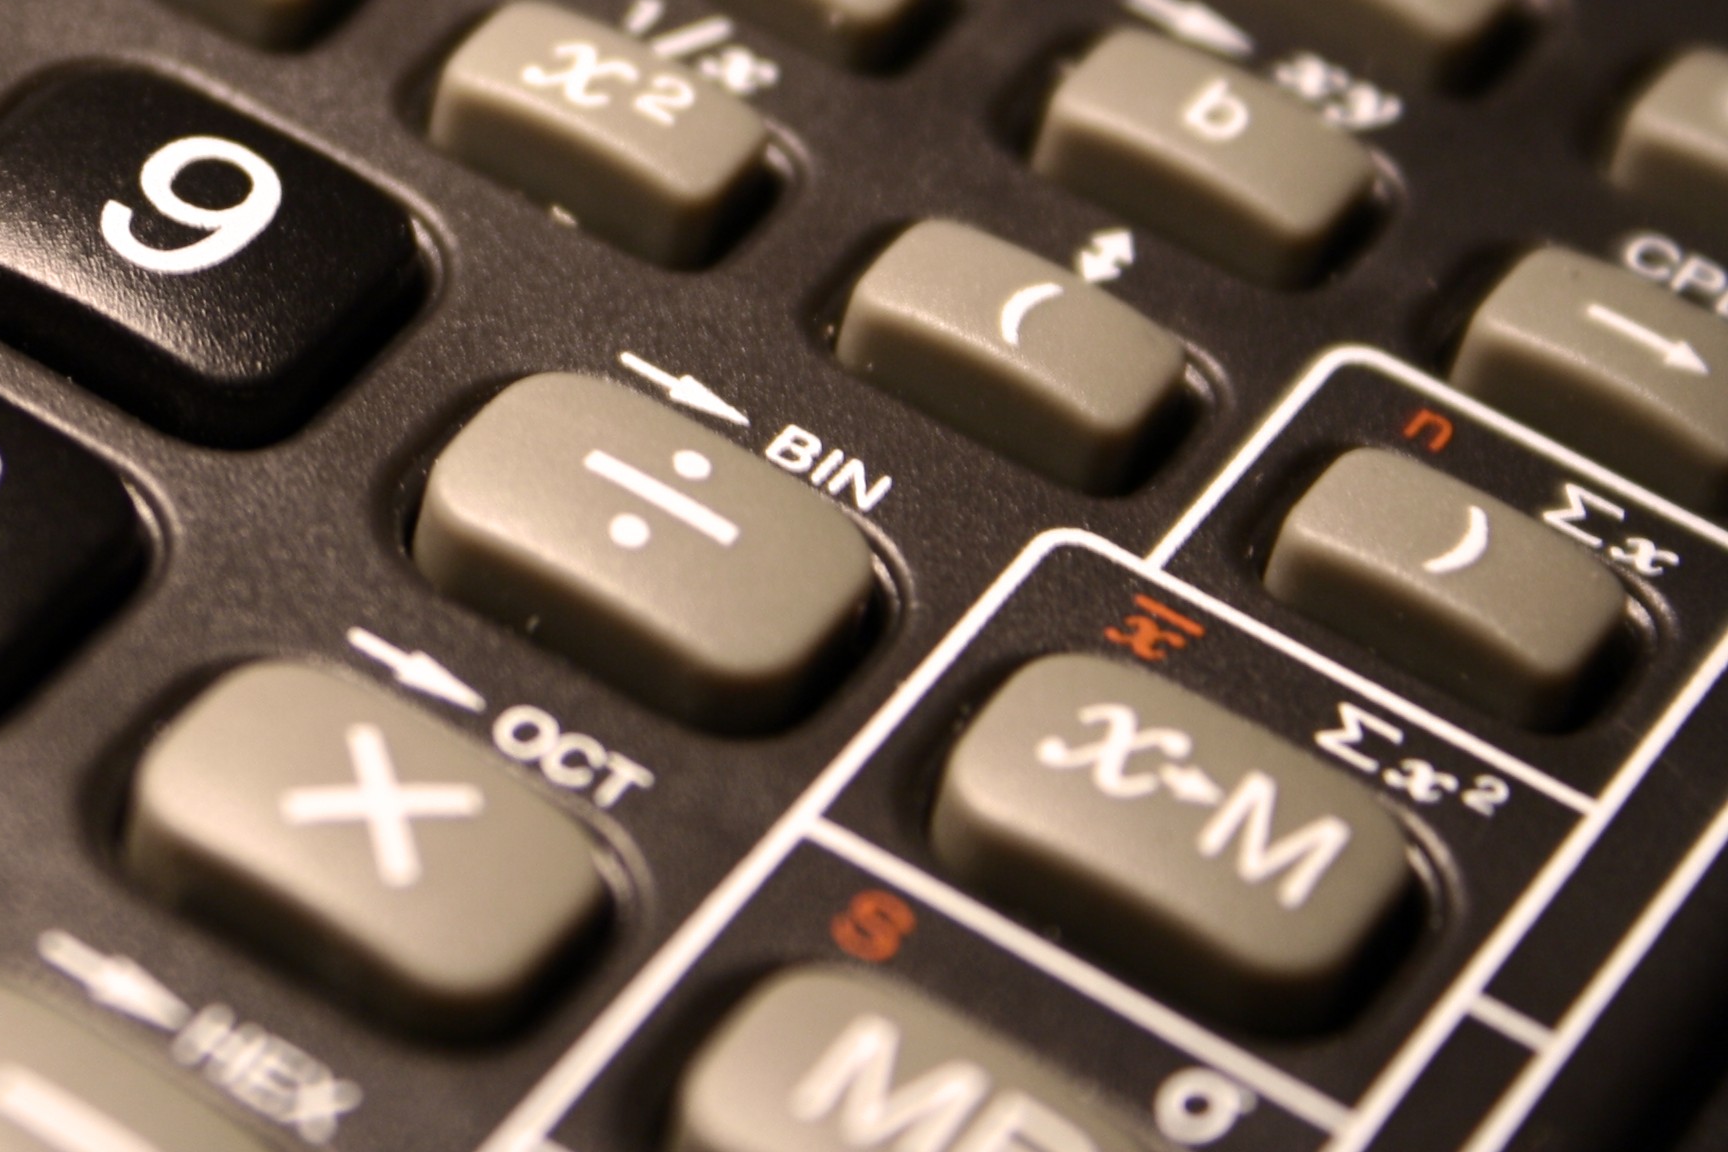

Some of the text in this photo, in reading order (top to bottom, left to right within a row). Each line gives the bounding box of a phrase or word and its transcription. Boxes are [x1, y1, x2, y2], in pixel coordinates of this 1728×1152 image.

[1183, 79, 1249, 142] b
[100, 135, 282, 274] 9
[1622, 234, 1728, 320] CP
[763, 422, 893, 512] BIN
[492, 705, 654, 810] OCT
[170, 1003, 362, 1141] HEX
